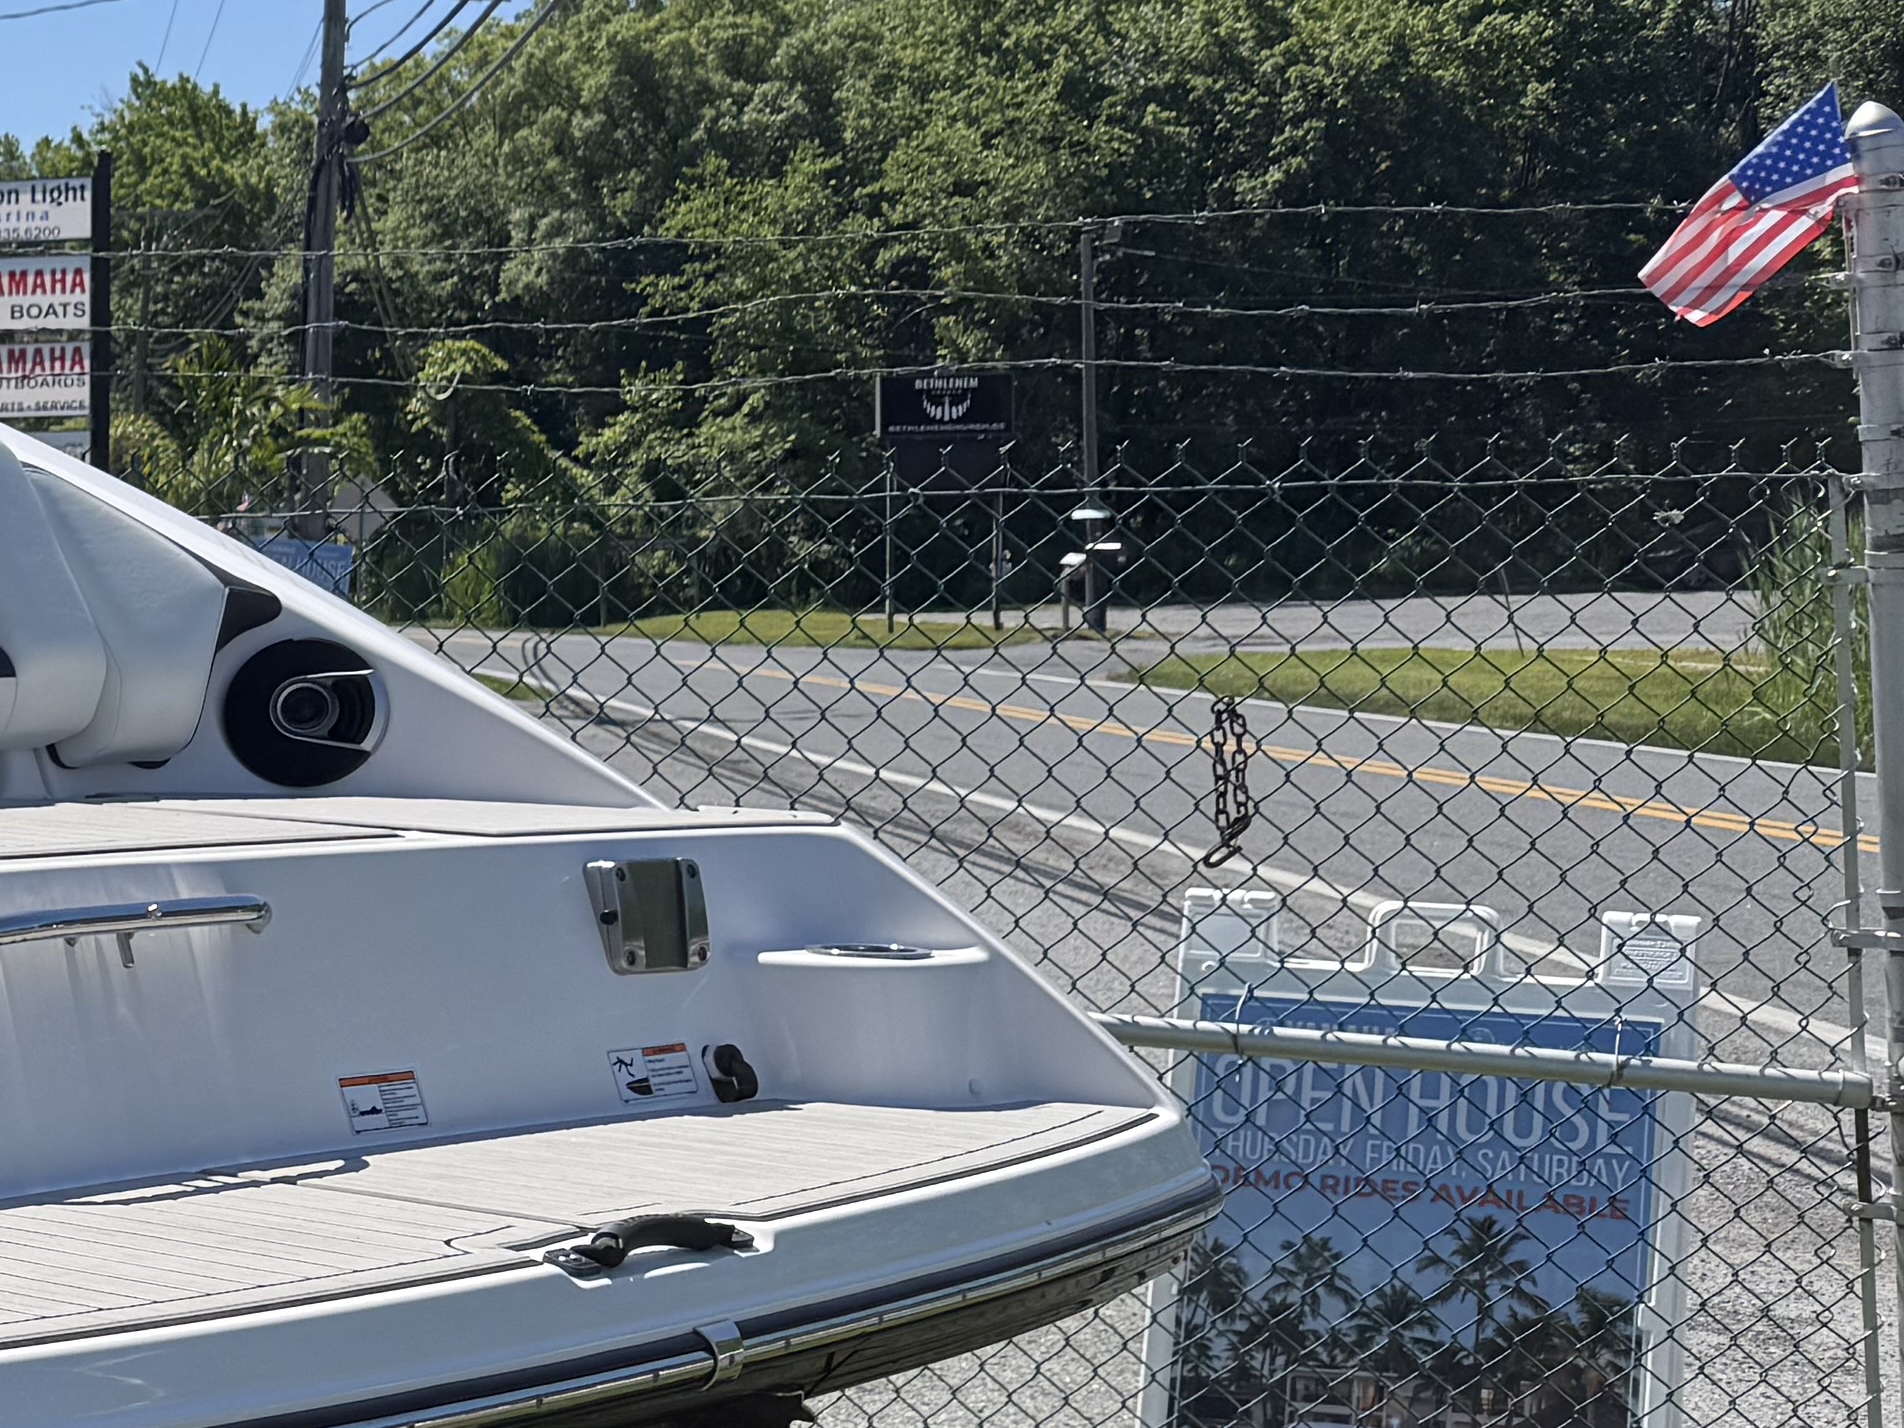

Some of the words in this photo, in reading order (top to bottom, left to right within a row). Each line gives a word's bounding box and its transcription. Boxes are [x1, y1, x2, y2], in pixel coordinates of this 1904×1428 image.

[31, 181, 86, 207] Light
[10, 302, 86, 320] BOATS
[915, 377, 978, 390] BETHLEHEM
[35, 399, 86, 412] SERVICE
[1211, 1053, 1386, 1135] OPEN
[1406, 1068, 1634, 1155] HOUSE
[1477, 1149, 1631, 1189] SATURDAY
[1211, 1164, 1310, 1191] DEMO
[1320, 1174, 1421, 1203] RIDES
[1430, 1183, 1631, 1220] AVAILABLE
